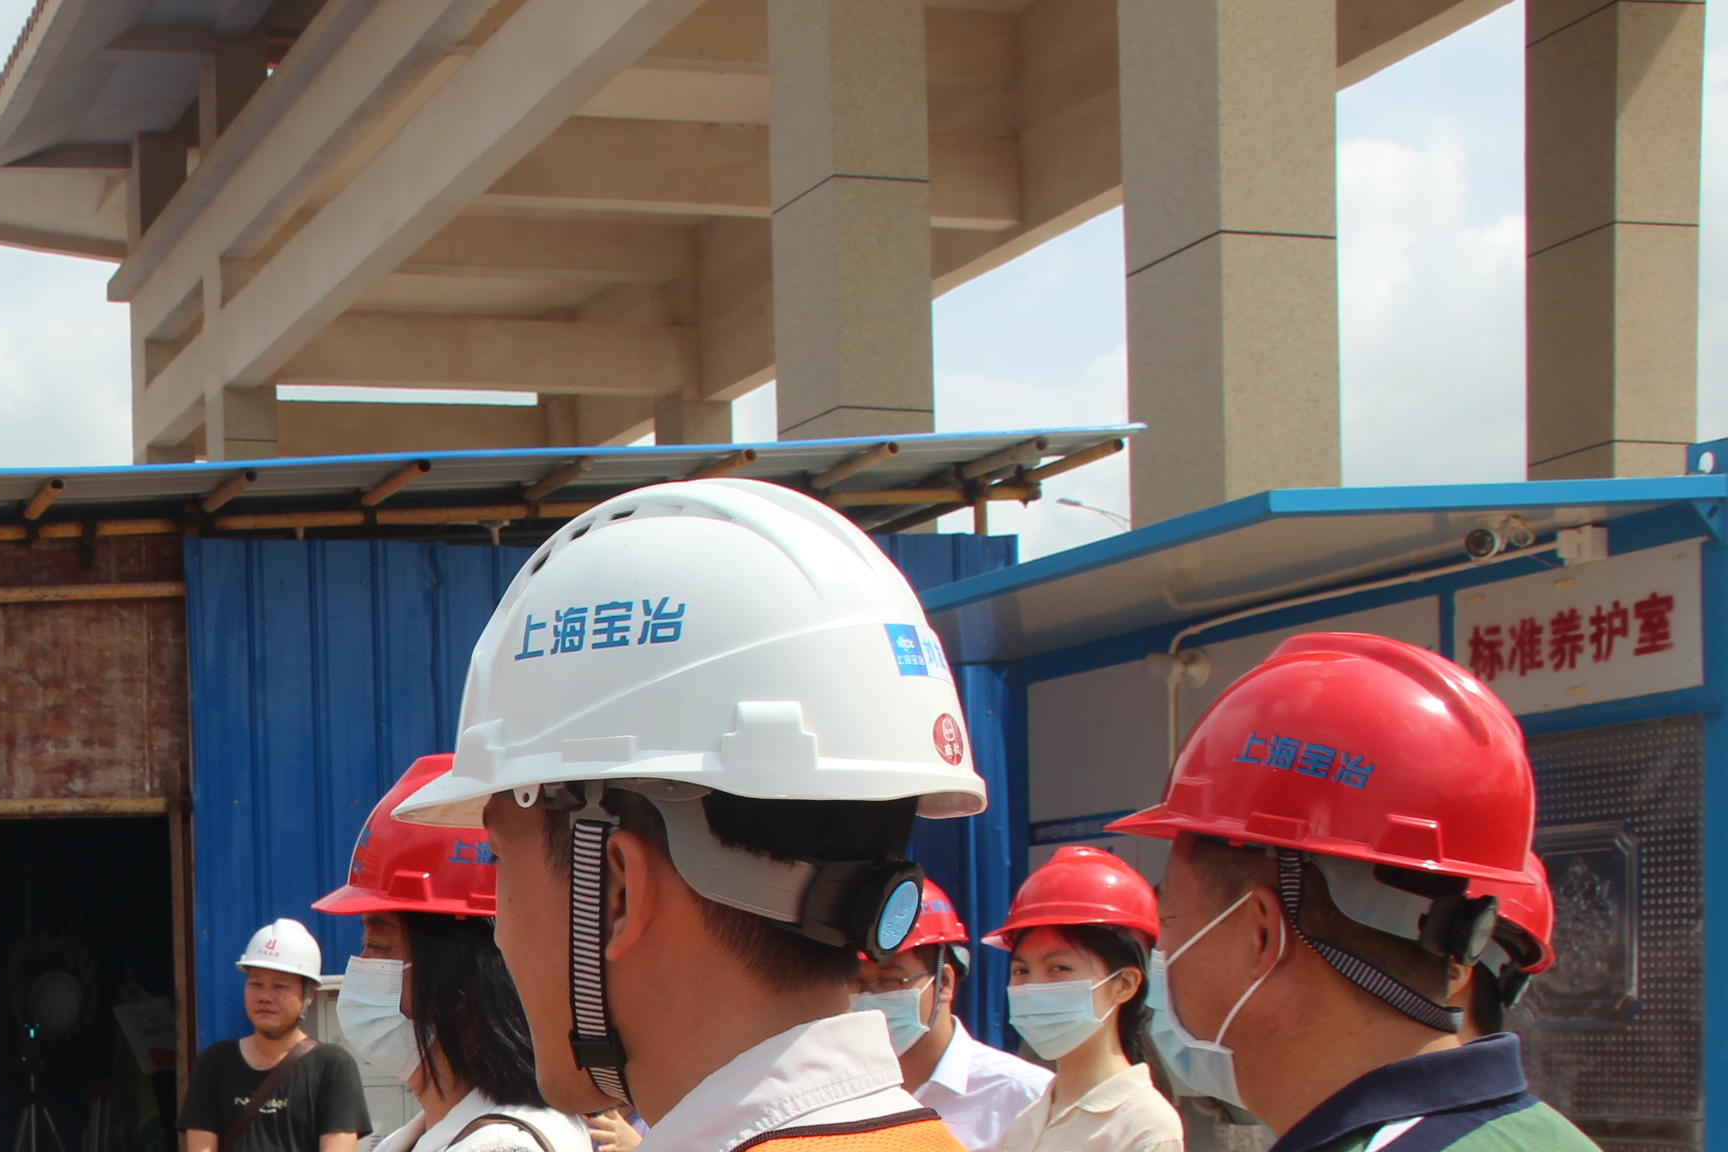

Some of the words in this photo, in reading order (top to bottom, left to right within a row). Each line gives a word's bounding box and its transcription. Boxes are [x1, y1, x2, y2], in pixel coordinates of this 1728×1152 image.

[514, 596, 686, 662] 上海宝冶
[1468, 592, 1675, 681] 标准养护室
[1233, 732, 1375, 789] 上海宝冶
